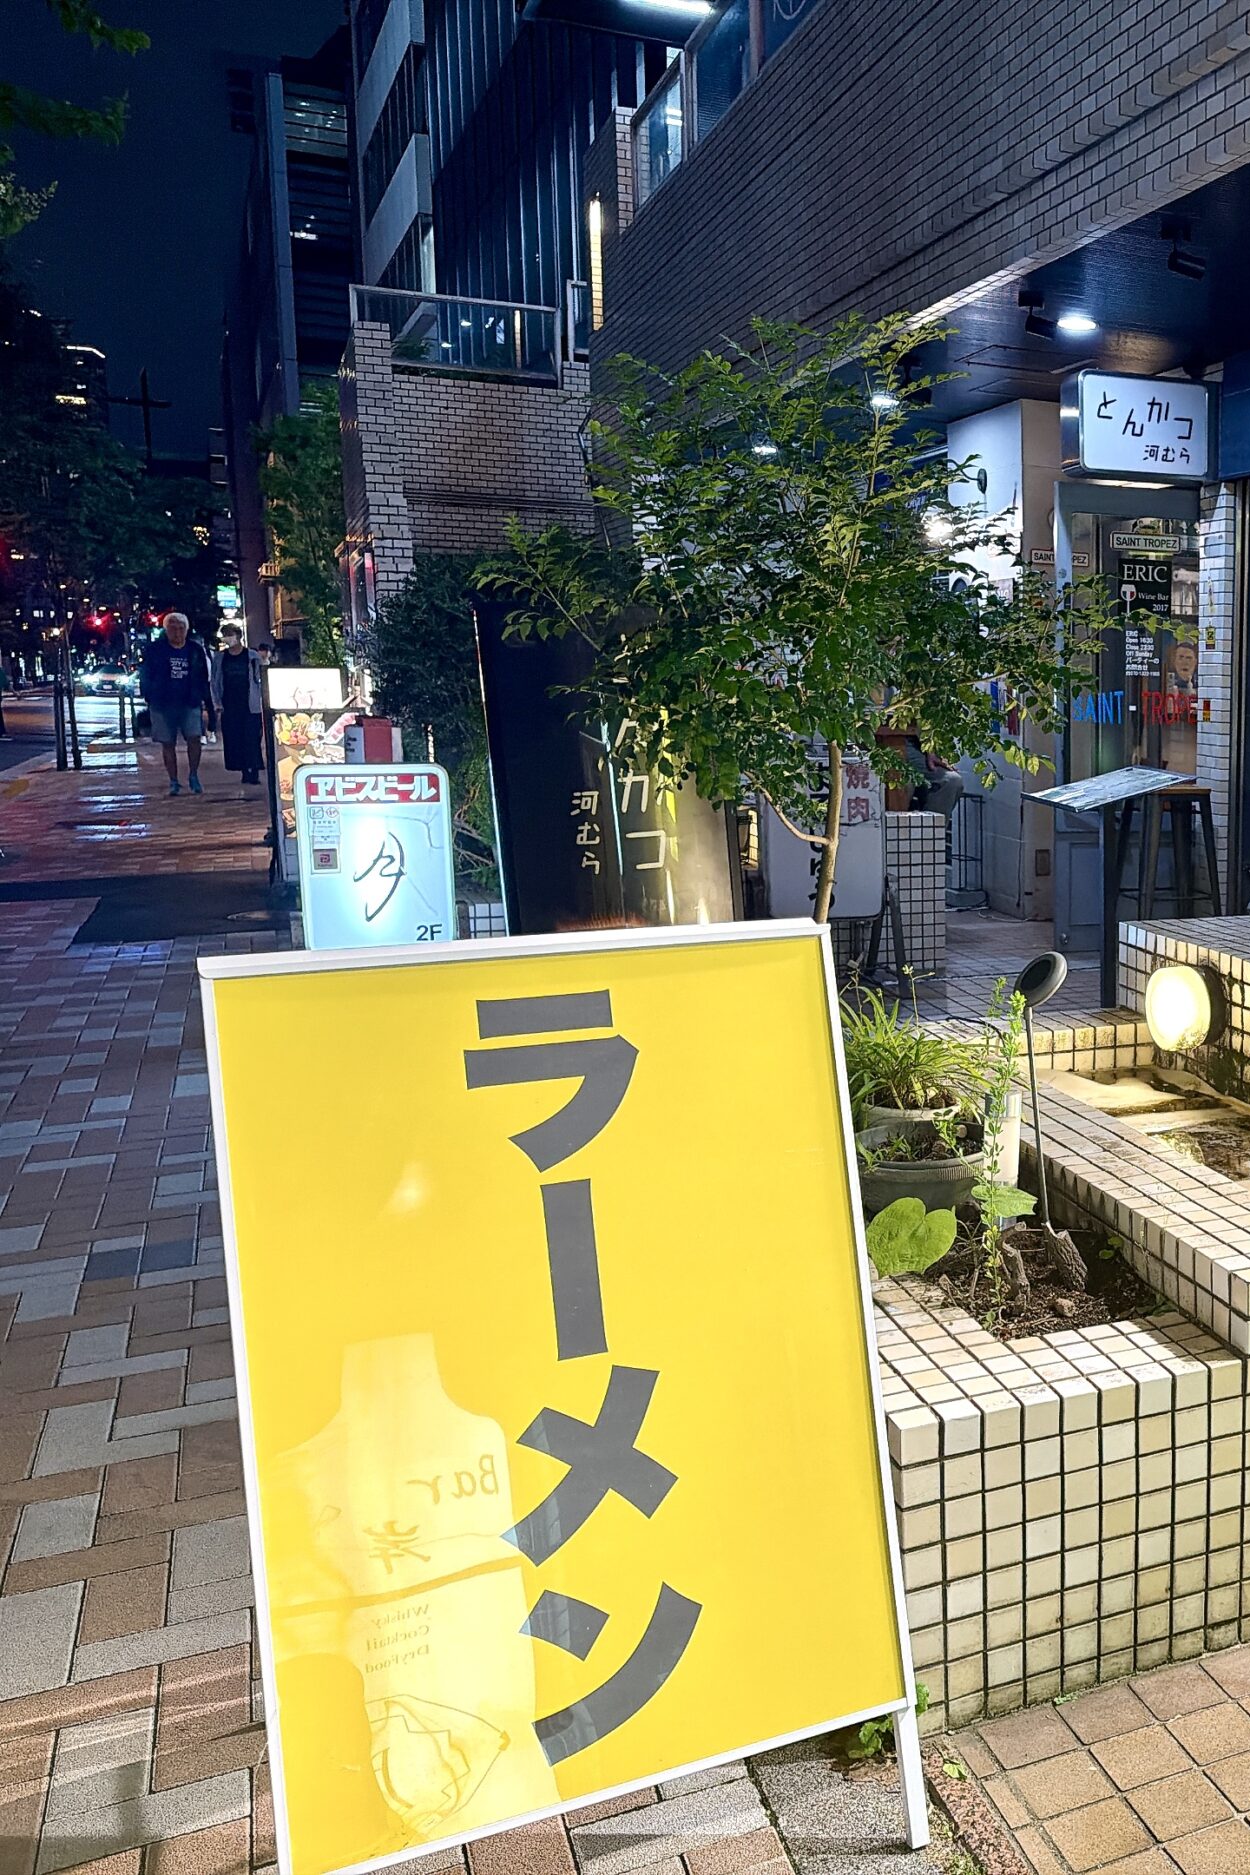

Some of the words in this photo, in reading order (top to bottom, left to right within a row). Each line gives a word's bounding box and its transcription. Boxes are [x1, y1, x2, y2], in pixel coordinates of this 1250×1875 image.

[1096, 390, 1194, 442] とんかつ
[1142, 444, 1191, 465] 河むら
[1115, 536, 1140, 548] SAINT
[1142, 536, 1178, 550] TROPEZ
[1122, 563, 1168, 583] ERIC
[1138, 591, 1157, 601] Wine
[1157, 592, 1169, 602] Bar
[1152, 603, 1169, 613] 2017
[1072, 690, 1125, 725] SAINT
[845, 763, 871, 823] 焼肉
[570, 789, 601, 875] 河むら
[416, 923, 443, 942] 2F
[463, 989, 703, 1767] ラーメン
